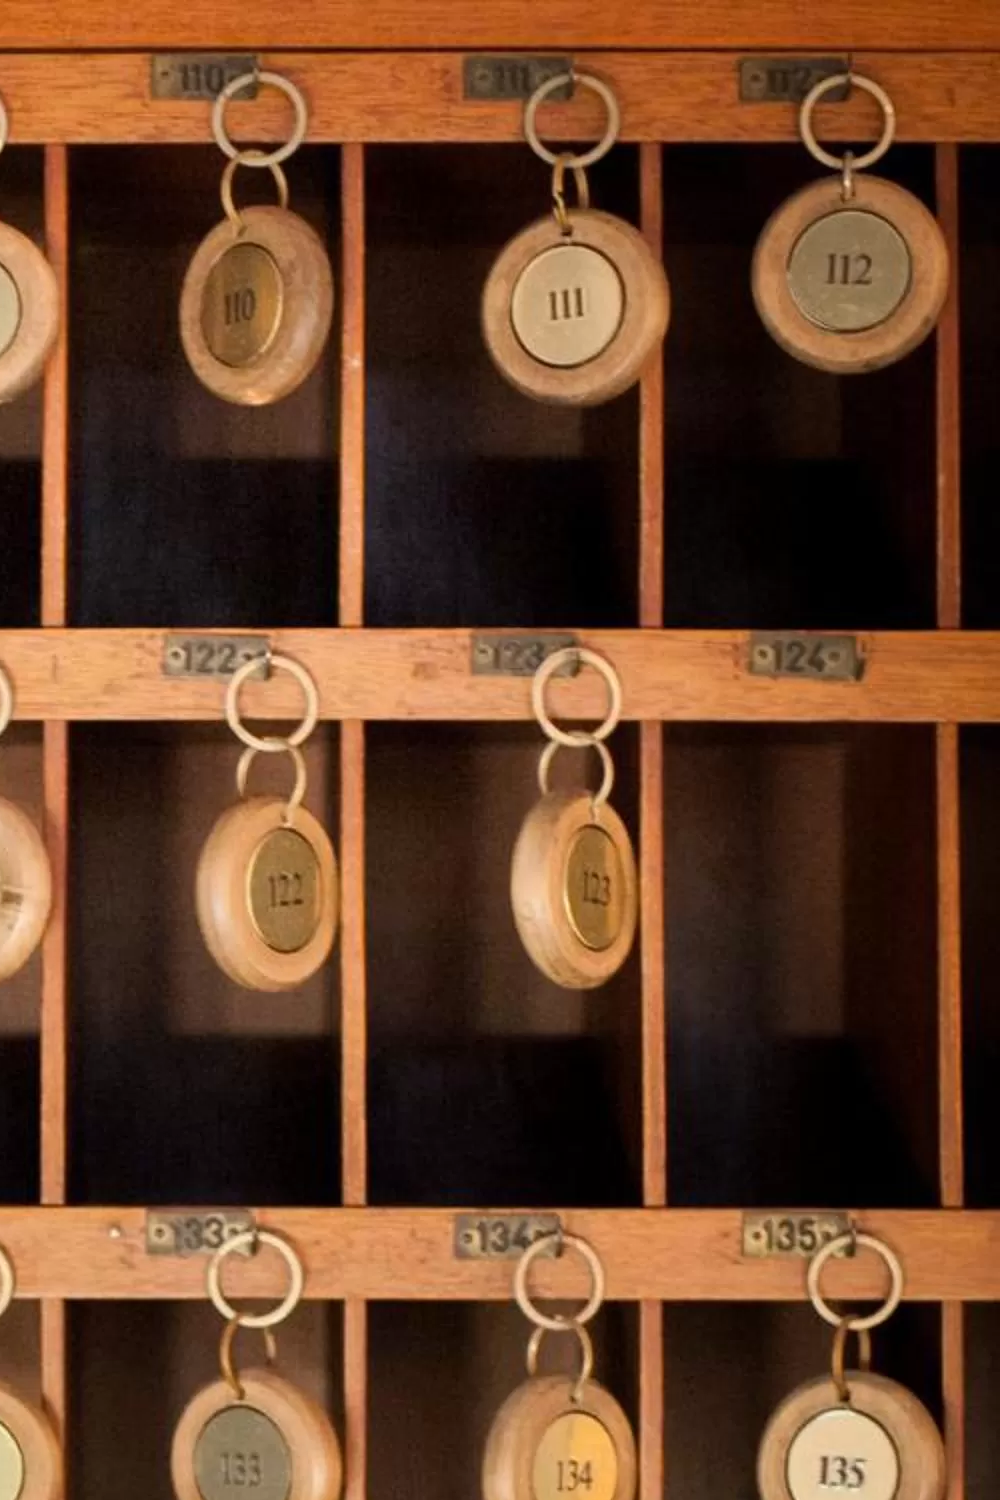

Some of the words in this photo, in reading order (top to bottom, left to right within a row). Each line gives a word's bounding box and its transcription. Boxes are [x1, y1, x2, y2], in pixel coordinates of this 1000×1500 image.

[180, 64, 223, 93] 110
[767, 67, 810, 95] 112
[827, 253, 872, 284] 112
[224, 288, 257, 325] 110
[549, 288, 584, 320] 111
[183, 641, 237, 674] 122
[493, 641, 545, 670] 123
[773, 641, 825, 673] 124
[268, 873, 304, 907] 122
[174, 1218, 225, 1250] 133
[477, 1221, 531, 1252] 134
[763, 1219, 816, 1252] 135
[220, 1452, 261, 1487] 133
[557, 1460, 592, 1491] 134
[820, 1456, 867, 1488] 135
